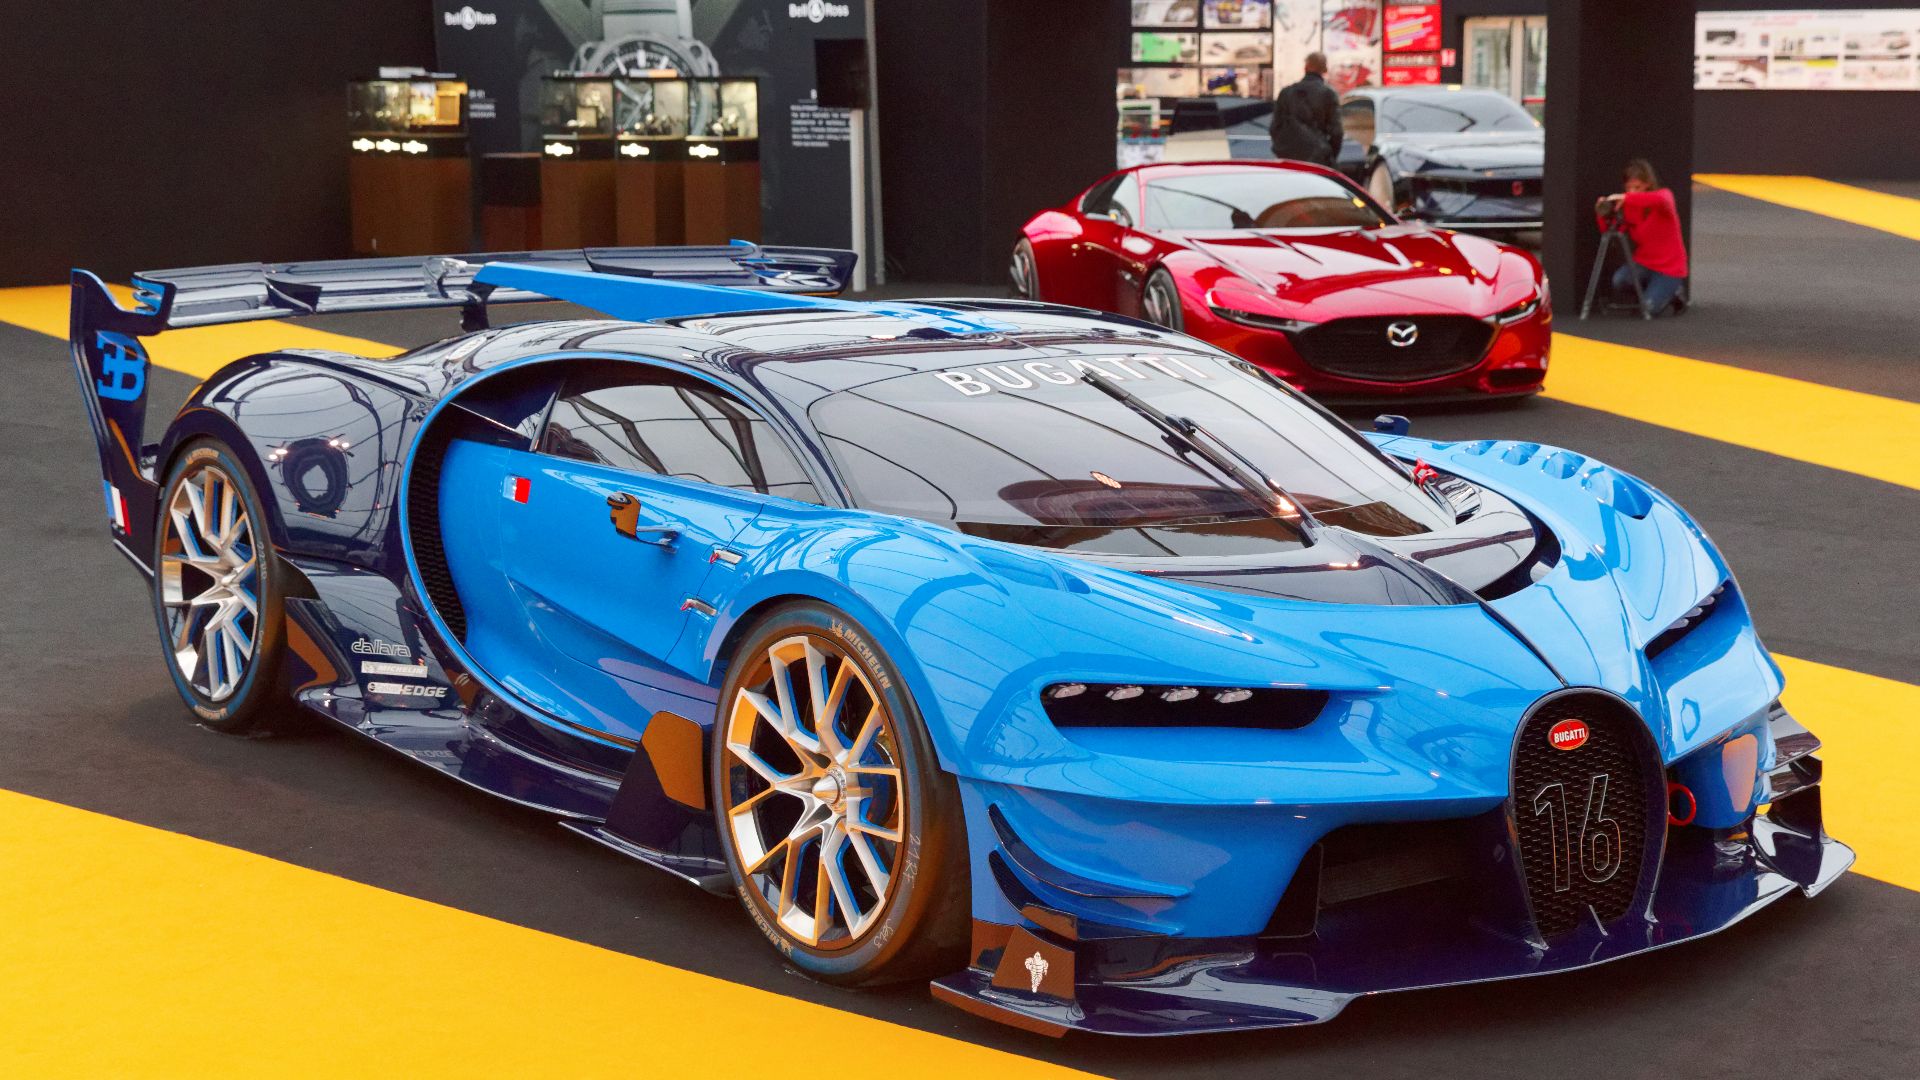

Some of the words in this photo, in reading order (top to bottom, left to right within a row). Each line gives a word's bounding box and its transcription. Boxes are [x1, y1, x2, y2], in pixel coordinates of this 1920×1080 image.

[934, 356, 1209, 397] BUGATTI
[351, 638, 412, 658] dallara
[843, 629, 892, 689] MICHELIN
[402, 684, 448, 698] EDGE
[1553, 727, 1586, 744] BUGATTI
[1534, 774, 1622, 893] 16
